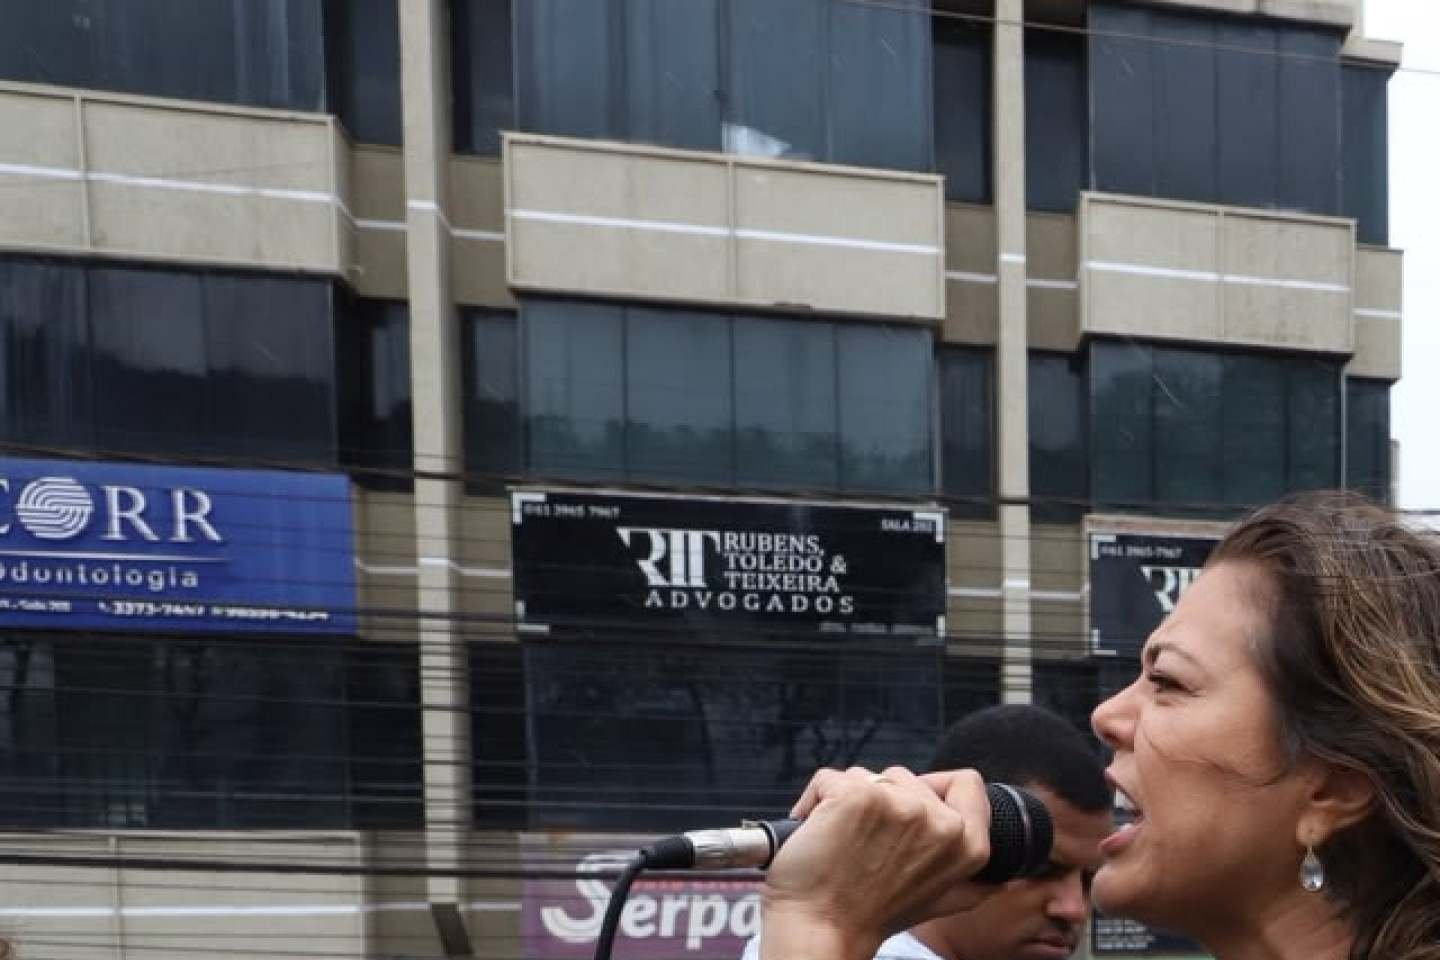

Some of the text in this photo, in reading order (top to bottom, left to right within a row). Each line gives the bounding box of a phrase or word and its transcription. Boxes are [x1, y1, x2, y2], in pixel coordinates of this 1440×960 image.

[724, 532, 824, 556] RUBENS,
[724, 552, 847, 574] TOLEDO &
[724, 571, 840, 593] TEIXEIRA
[645, 589, 854, 613] ADVOGADOS
